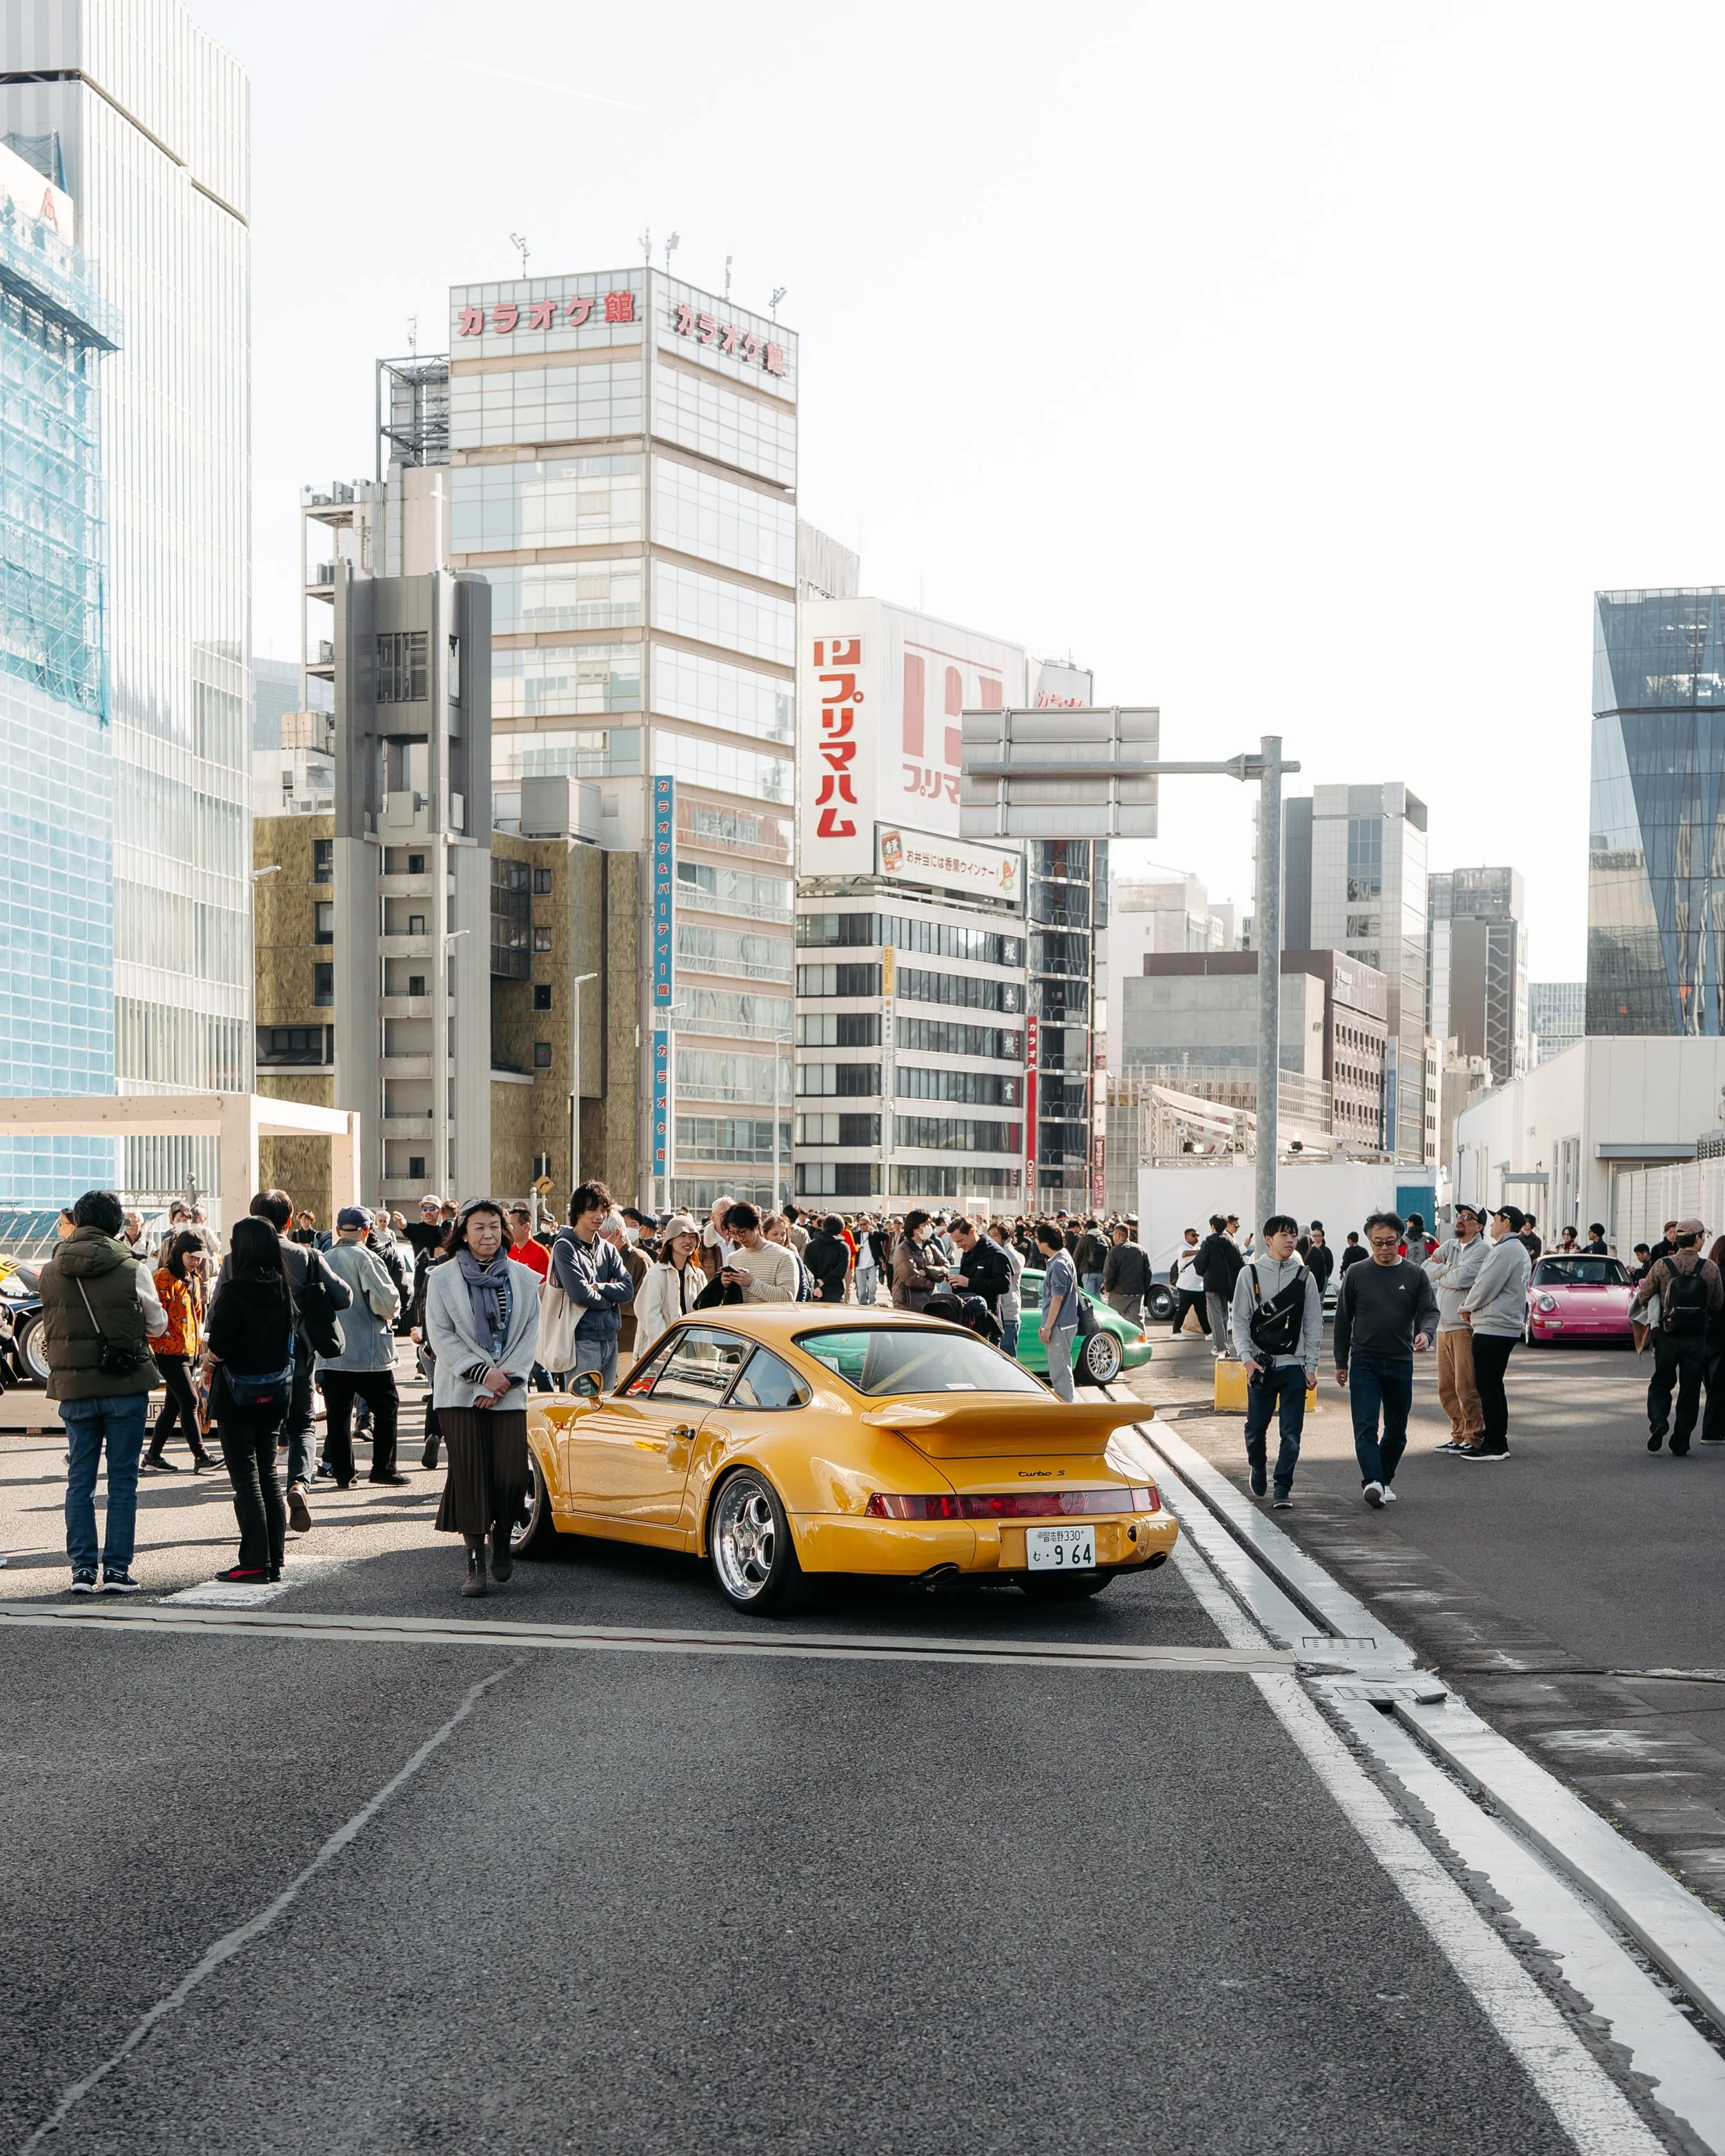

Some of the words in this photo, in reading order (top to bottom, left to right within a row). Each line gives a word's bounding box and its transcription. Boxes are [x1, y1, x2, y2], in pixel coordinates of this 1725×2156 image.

[457, 290, 635, 337] カラオケ館
[675, 304, 785, 376] カラオケ館
[815, 673, 865, 838] プリマハム
